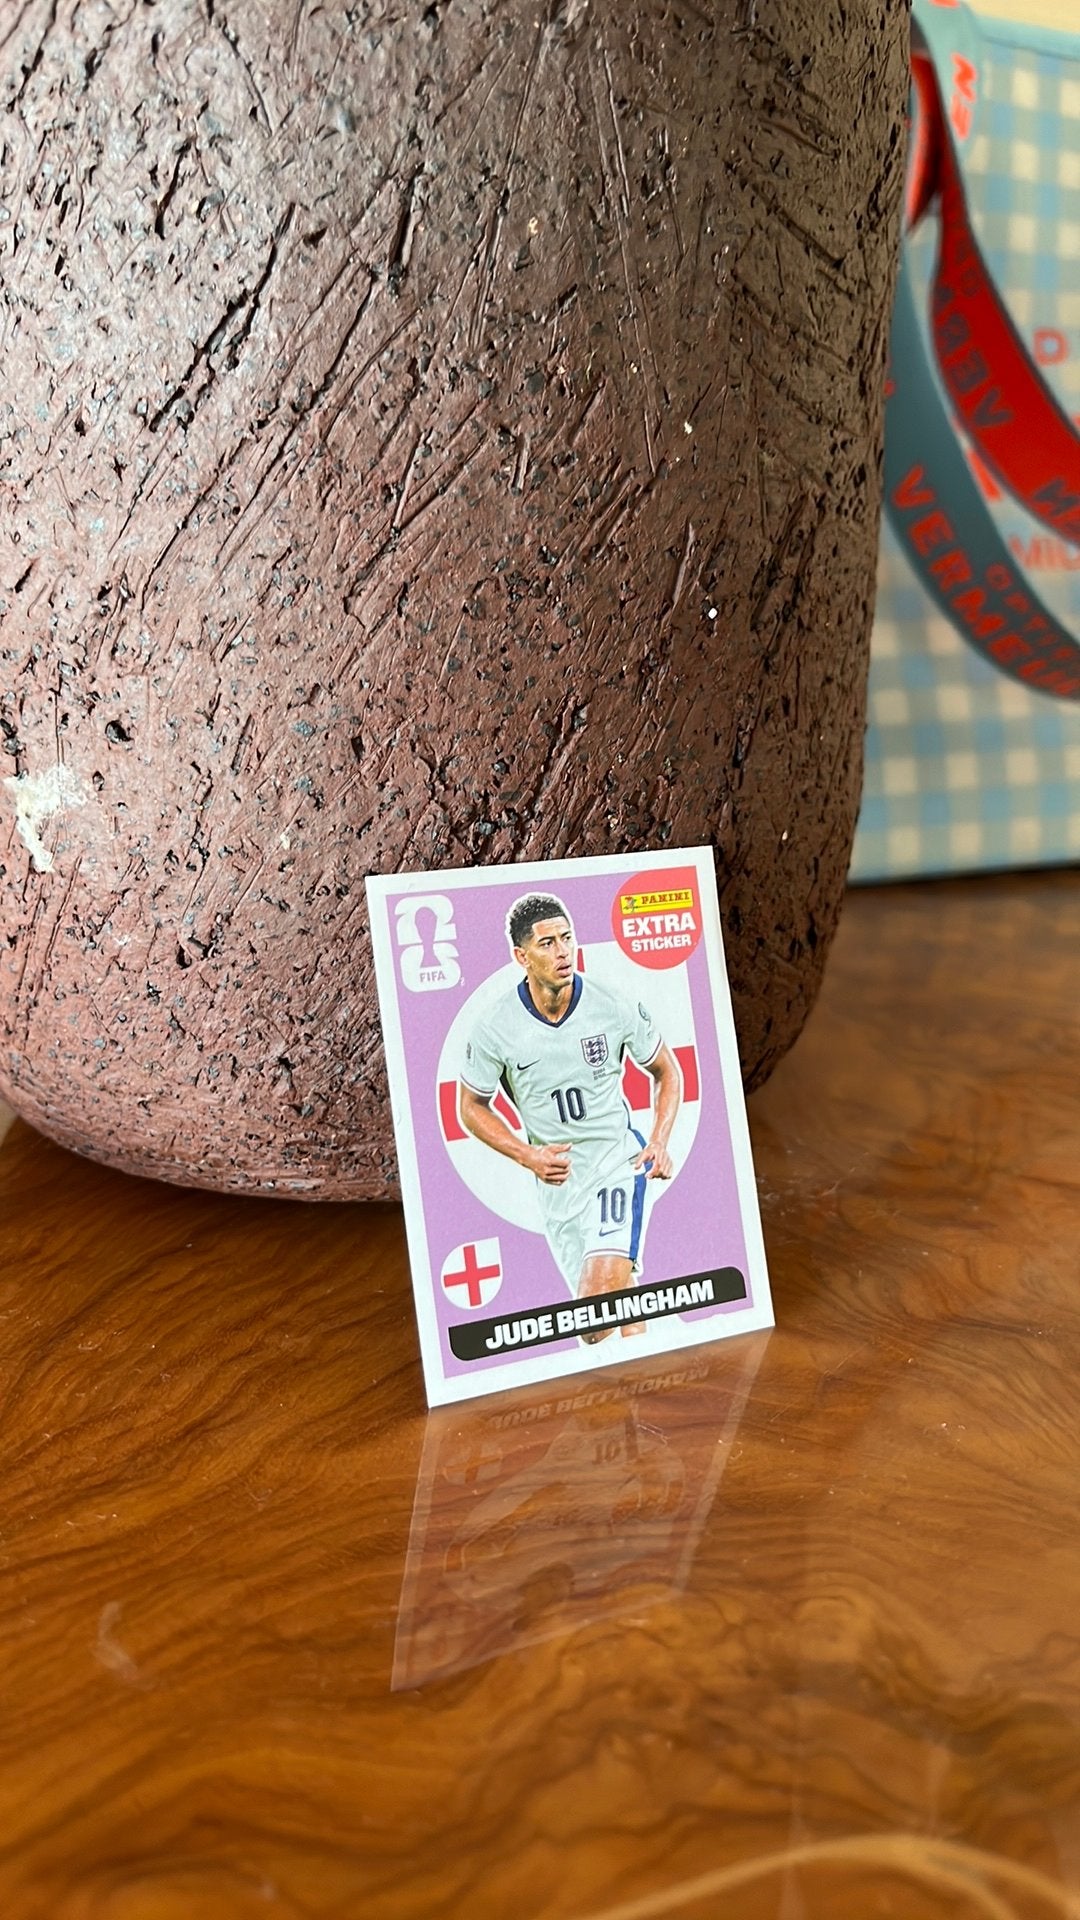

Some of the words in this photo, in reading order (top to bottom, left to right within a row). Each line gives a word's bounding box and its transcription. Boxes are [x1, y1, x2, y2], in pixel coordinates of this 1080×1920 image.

[641, 891, 690, 905] PANINI
[622, 911, 697, 938] EXTRA
[631, 934, 692, 953] STICKER
[419, 970, 447, 983] FIFA
[550, 1087, 588, 1124] 10
[597, 1187, 626, 1224] 10
[485, 1313, 554, 1350] JUDE
[556, 1279, 715, 1335] BELLINGHAM
